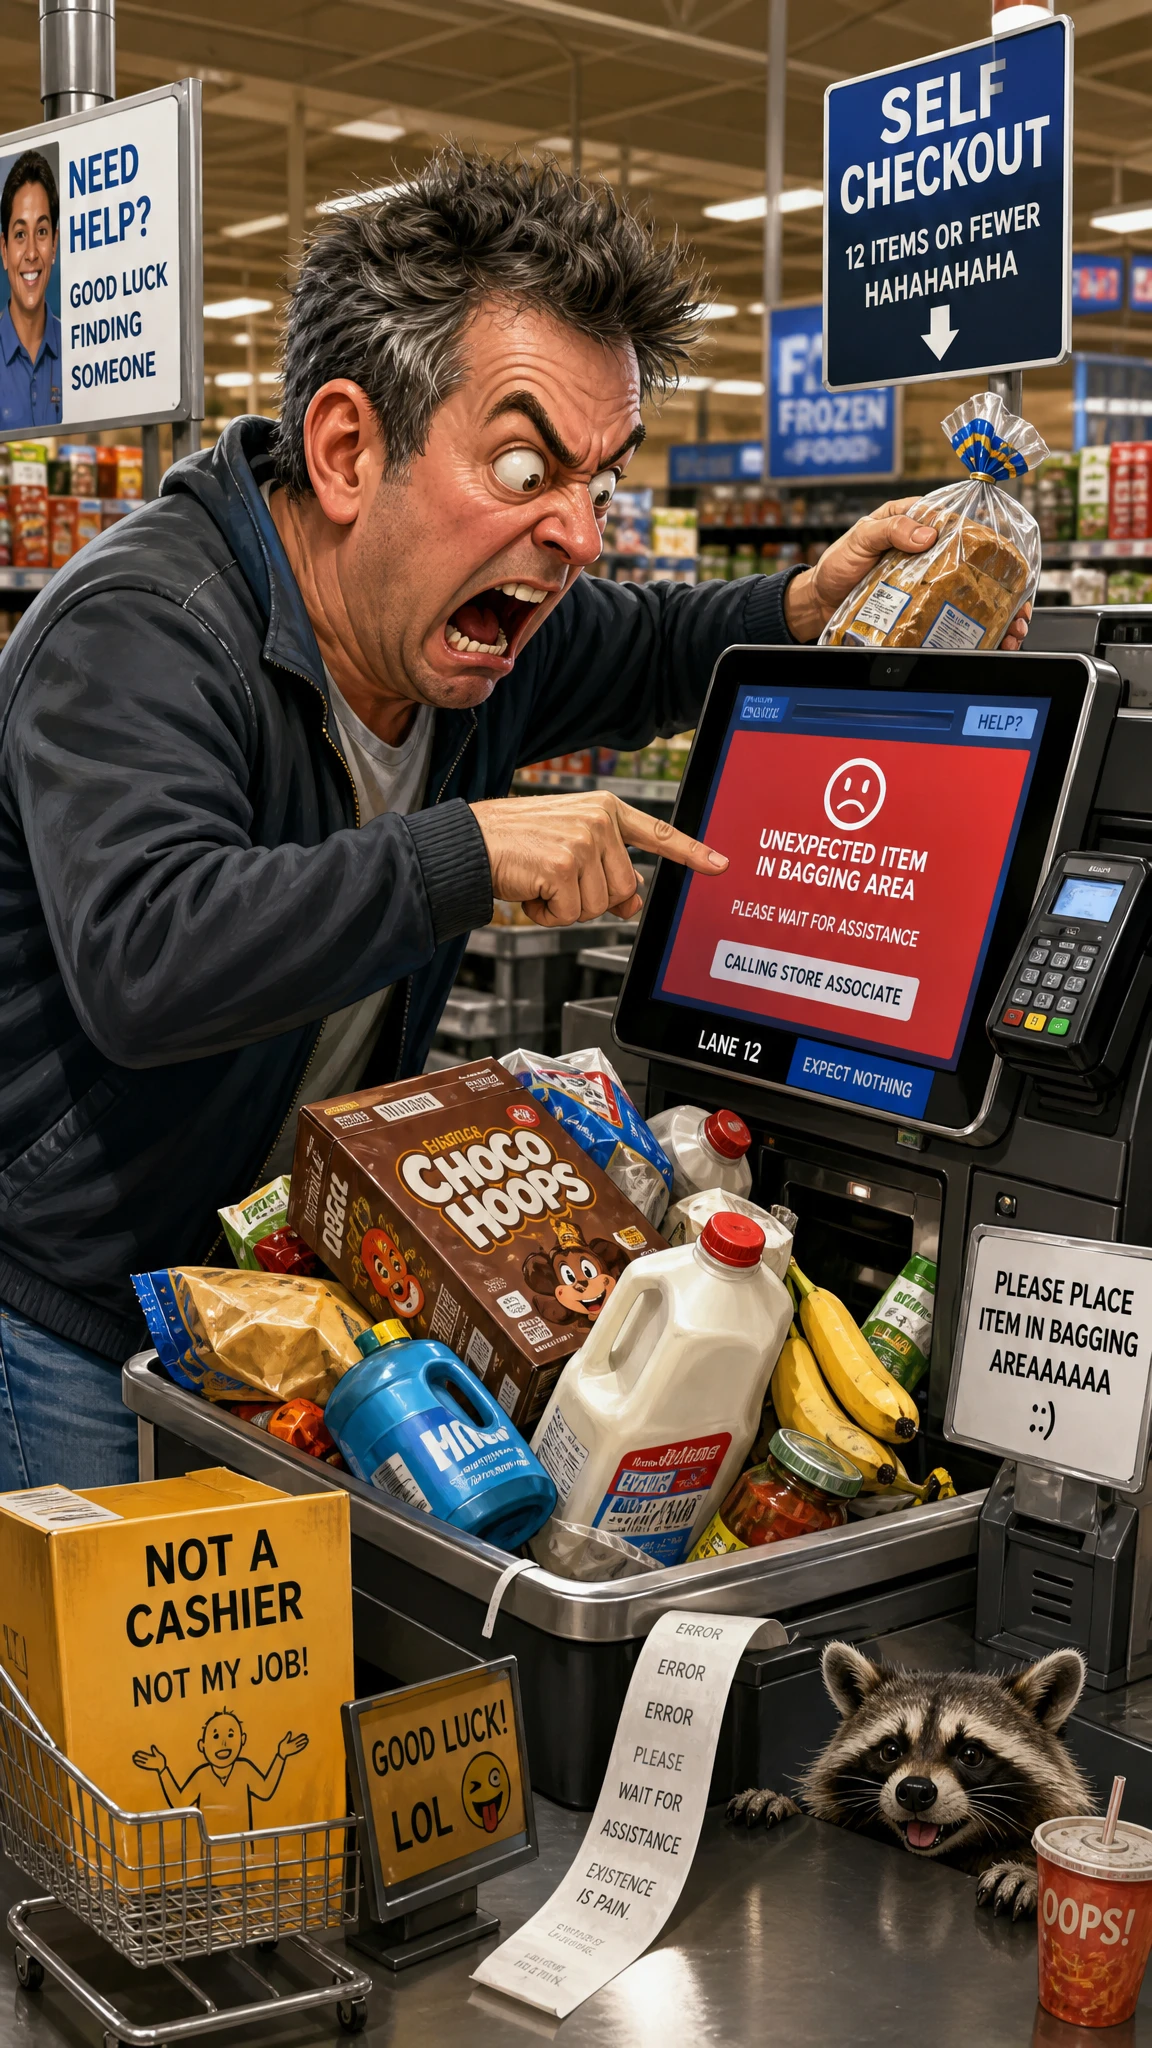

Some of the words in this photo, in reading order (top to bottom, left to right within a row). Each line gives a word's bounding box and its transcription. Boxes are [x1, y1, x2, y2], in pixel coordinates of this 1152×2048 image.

[880, 58, 1006, 144] SELF
[69, 143, 139, 198] NEED
[840, 114, 1050, 215] CHECKOUT
[69, 195, 151, 253] HELP?
[845, 243, 865, 270] 12
[871, 228, 929, 266] ITEMS
[935, 220, 963, 249] OR
[970, 202, 1041, 243] FEWER
[70, 271, 117, 309] GOOD
[122, 261, 168, 297] LUCK
[865, 250, 1019, 308] HAHAHAHAHA
[71, 311, 142, 349] FINDING
[71, 351, 156, 390] SOMEONE
[777, 394, 887, 436] FROZEN
[977, 713, 1023, 732] HELP?
[759, 828, 876, 865] UNEXPECTED
[880, 845, 929, 873] ITEM
[755, 856, 776, 877] IN
[778, 859, 861, 892] BAGGING
[863, 873, 915, 901] AREA
[731, 899, 776, 922] PLEASE
[778, 907, 809, 927] WAIT
[810, 913, 836, 933] FOR
[837, 918, 920, 948] ASSISTANCE
[724, 953, 778, 978] CALLING
[780, 964, 823, 988] STORE
[825, 974, 903, 1006] ASSOCIATE
[697, 1029, 740, 1057] LANE
[743, 1040, 762, 1064] 12
[802, 1056, 852, 1083] EXPECT
[852, 1069, 913, 1099] NOTHING
[402, 1130, 552, 1204] CHOCO
[444, 1162, 591, 1249] HOOPS
[994, 1270, 1065, 1304] PLEASE
[1069, 1281, 1134, 1316] PLACE
[978, 1306, 1021, 1337] ITEM
[1025, 1315, 1045, 1341] IN
[1049, 1318, 1139, 1358] BAGGING
[989, 1348, 1111, 1396] AREAAAAAA
[145, 1533, 233, 1587] NOT
[249, 1528, 279, 1572] A
[126, 1580, 304, 1648] CASHIER
[675, 1622, 724, 1641] ERROR
[132, 1667, 190, 1707] NOT
[201, 1658, 241, 1694] MY
[250, 1646, 310, 1686] JOB!
[656, 1658, 706, 1682] ERROR
[371, 1726, 436, 1777] GOOD
[441, 1699, 508, 1754] LUCK!
[644, 1701, 694, 1727] ERROR
[632, 1745, 685, 1772] PLEASE
[618, 1781, 653, 1808] WAIT
[655, 1789, 683, 1813] FOR
[391, 1796, 454, 1853] LOL
[600, 1819, 682, 1856] ASSISTANCE
[576, 1887, 595, 1906] IS
[597, 1894, 631, 1921] PAIN.
[586, 1862, 657, 1898] EXISTENCE
[1042, 1887, 1137, 1947] OOPS!
